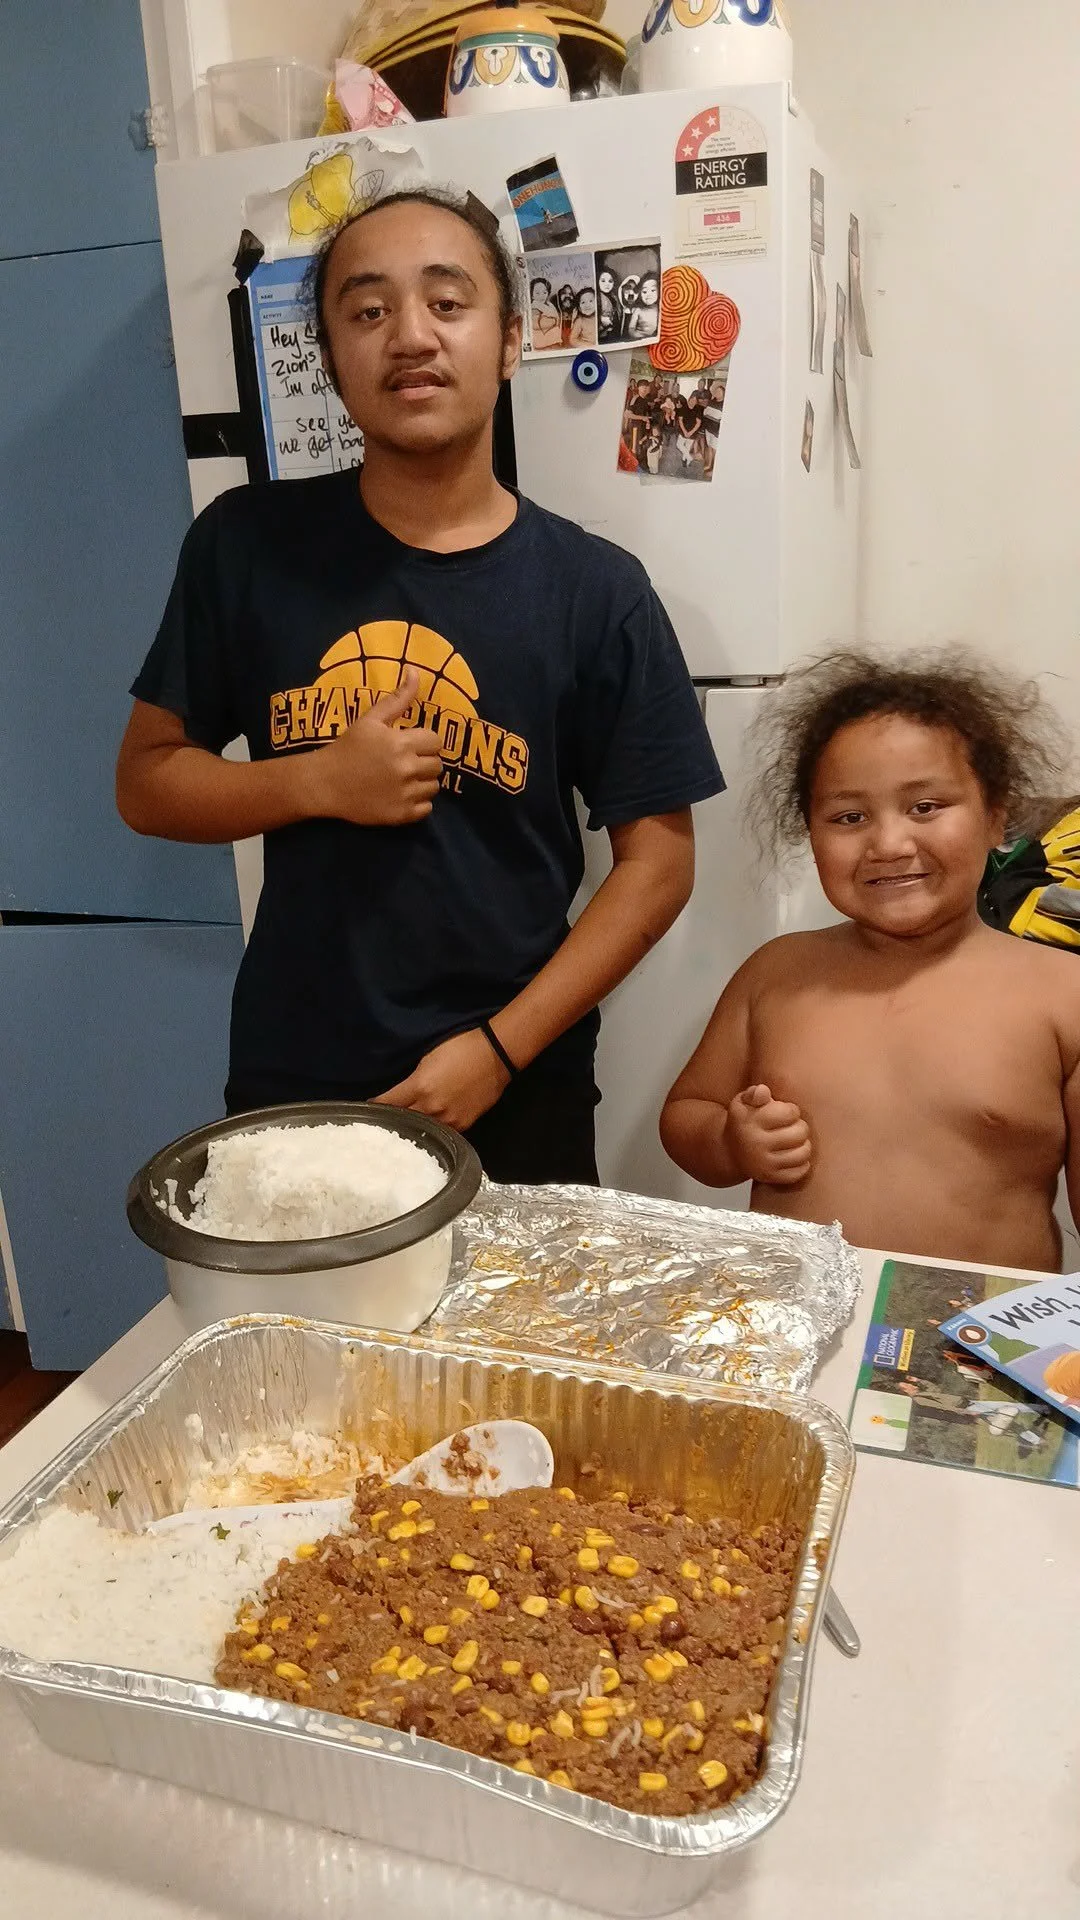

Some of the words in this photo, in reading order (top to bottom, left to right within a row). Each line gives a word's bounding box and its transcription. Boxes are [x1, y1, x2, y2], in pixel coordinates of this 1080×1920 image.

[694, 158, 748, 176] ENERGY
[695, 172, 747, 190] RATING
[270, 325, 302, 359] Hey
[271, 351, 317, 376] Zion's
[280, 438, 301, 455] we
[307, 431, 335, 459] get
[338, 433, 364, 451] bac
